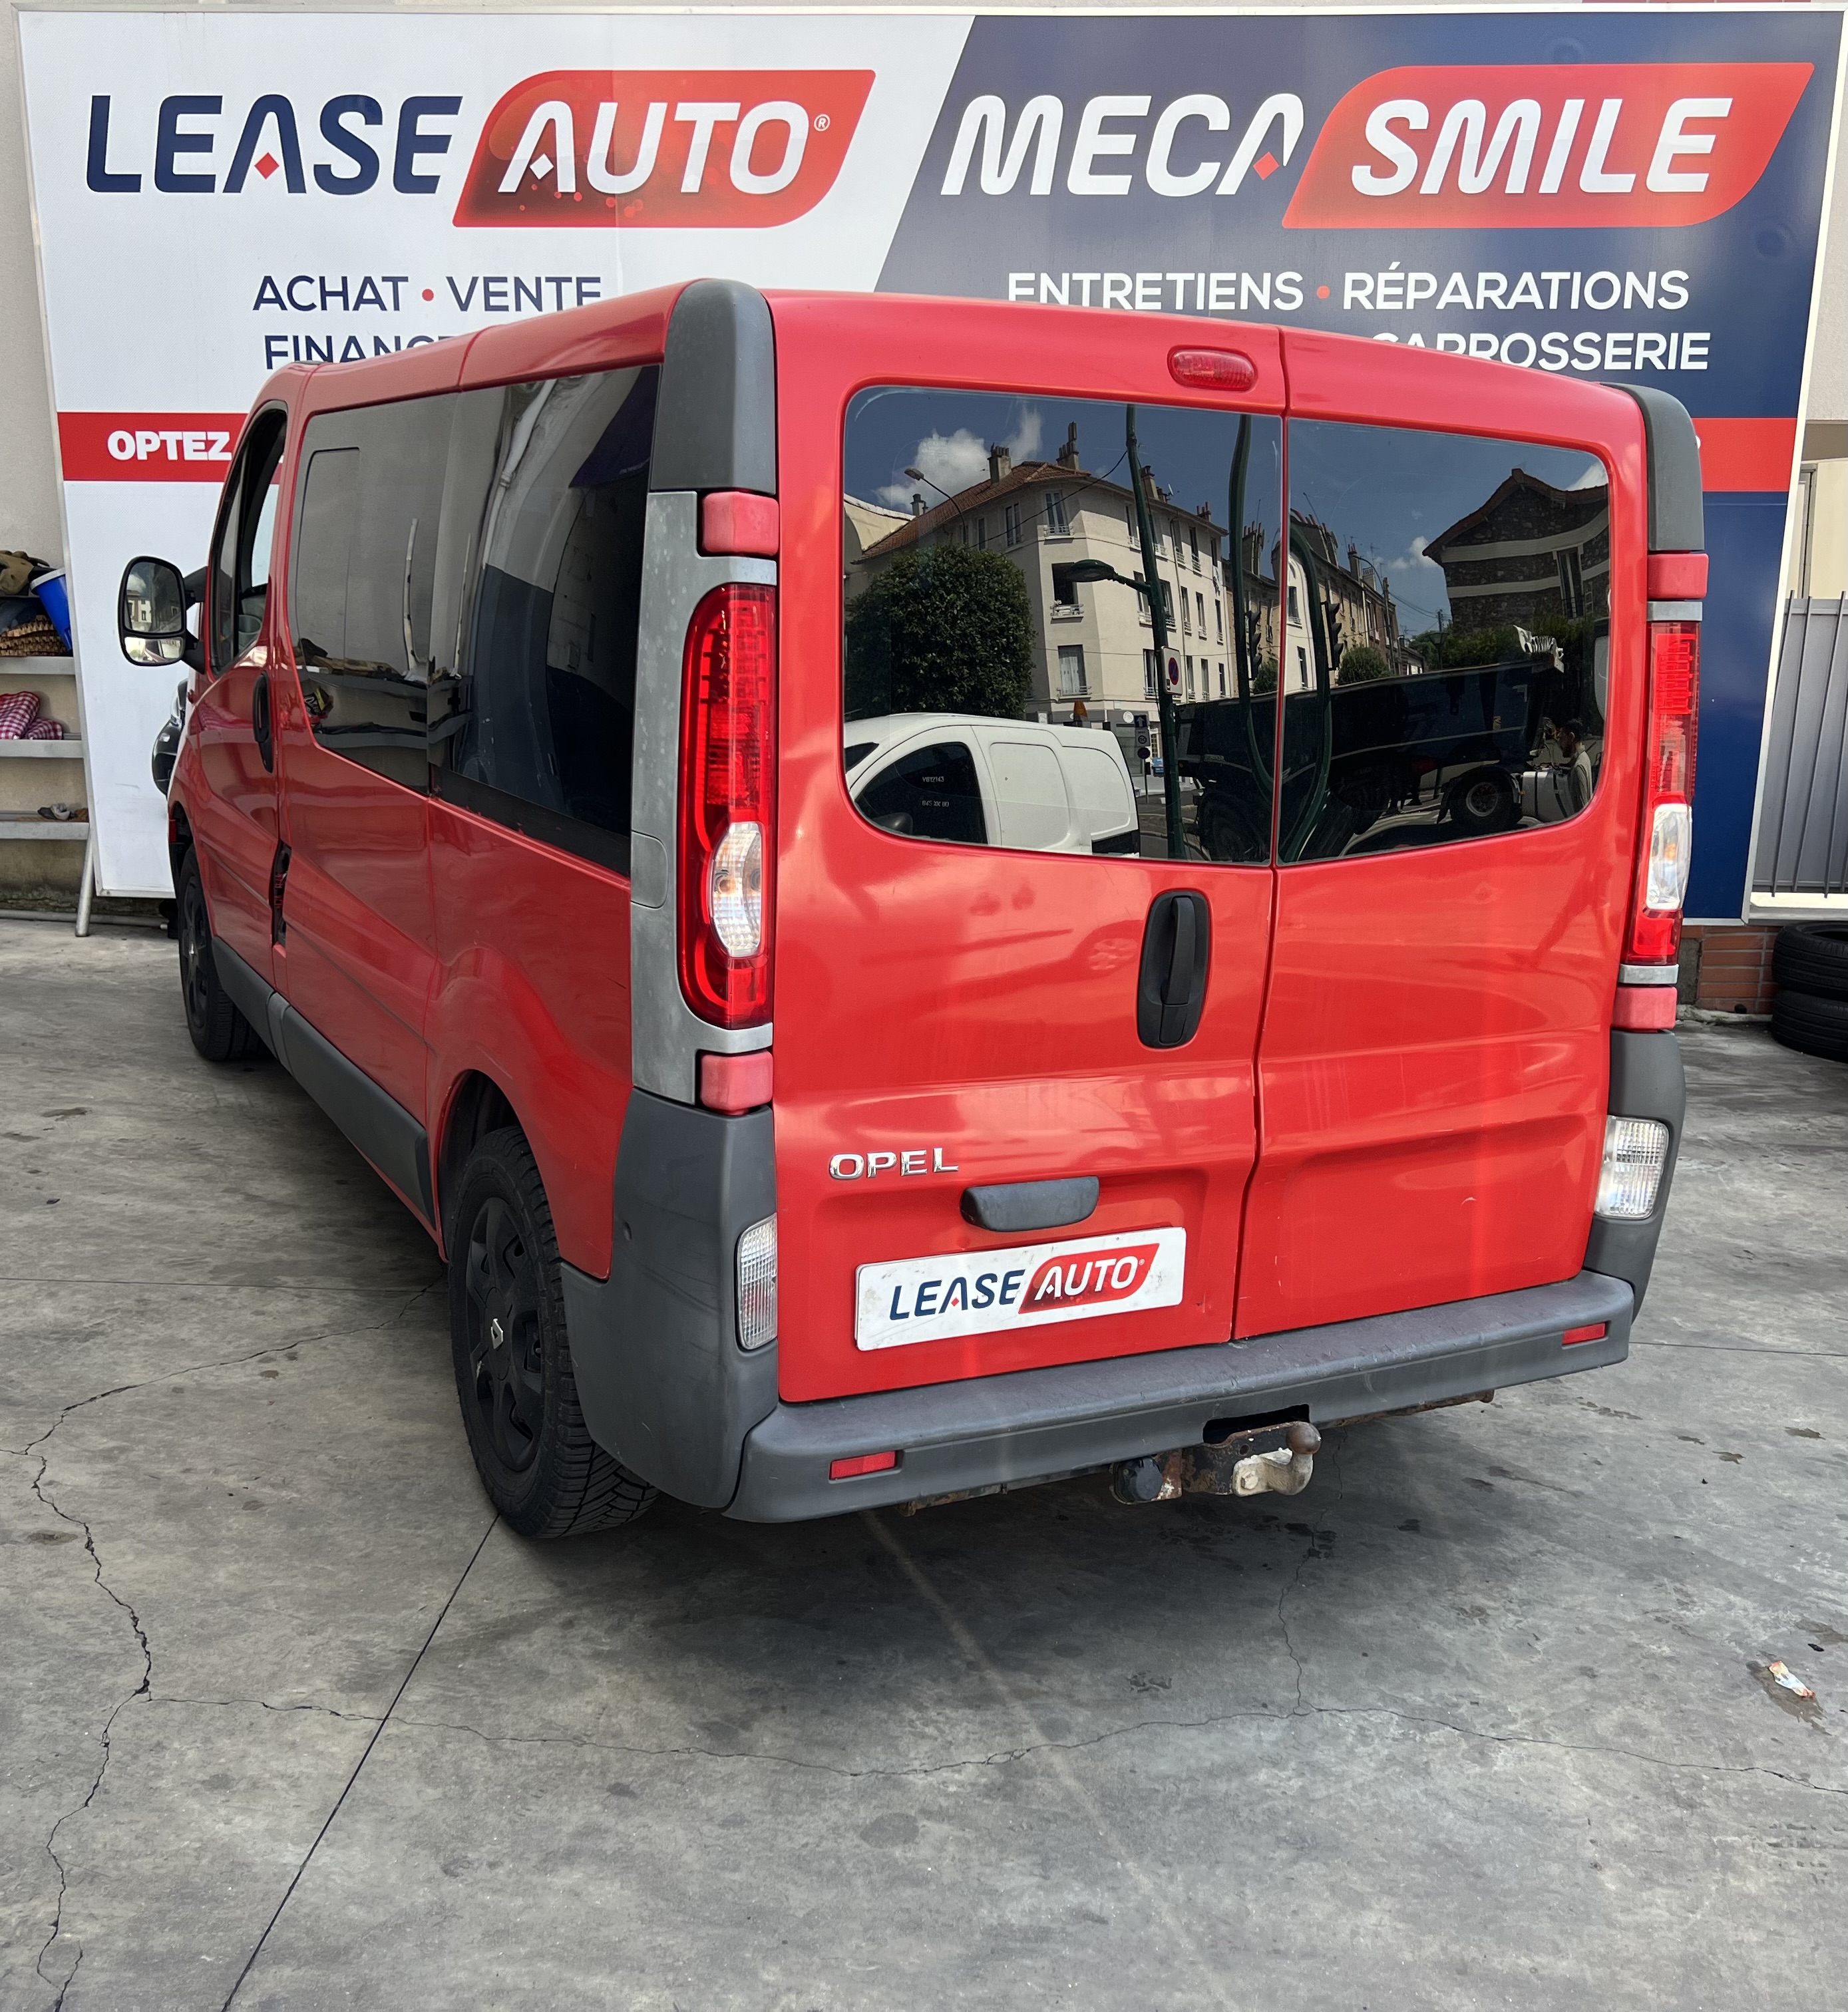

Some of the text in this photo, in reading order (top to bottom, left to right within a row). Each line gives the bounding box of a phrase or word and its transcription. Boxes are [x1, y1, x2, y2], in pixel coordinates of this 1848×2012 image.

[87, 94, 463, 195] LEASE
[940, 93, 1733, 197] MECA SMILE
[253, 275, 601, 311] ACHAT VENTE
[1008, 261, 1690, 311] ENTRETIENS RÉPARATIONS
[107, 430, 232, 461] OPTEZ
[829, 1148, 958, 1180] OPEL
[889, 1269, 1025, 1320] LEASE
